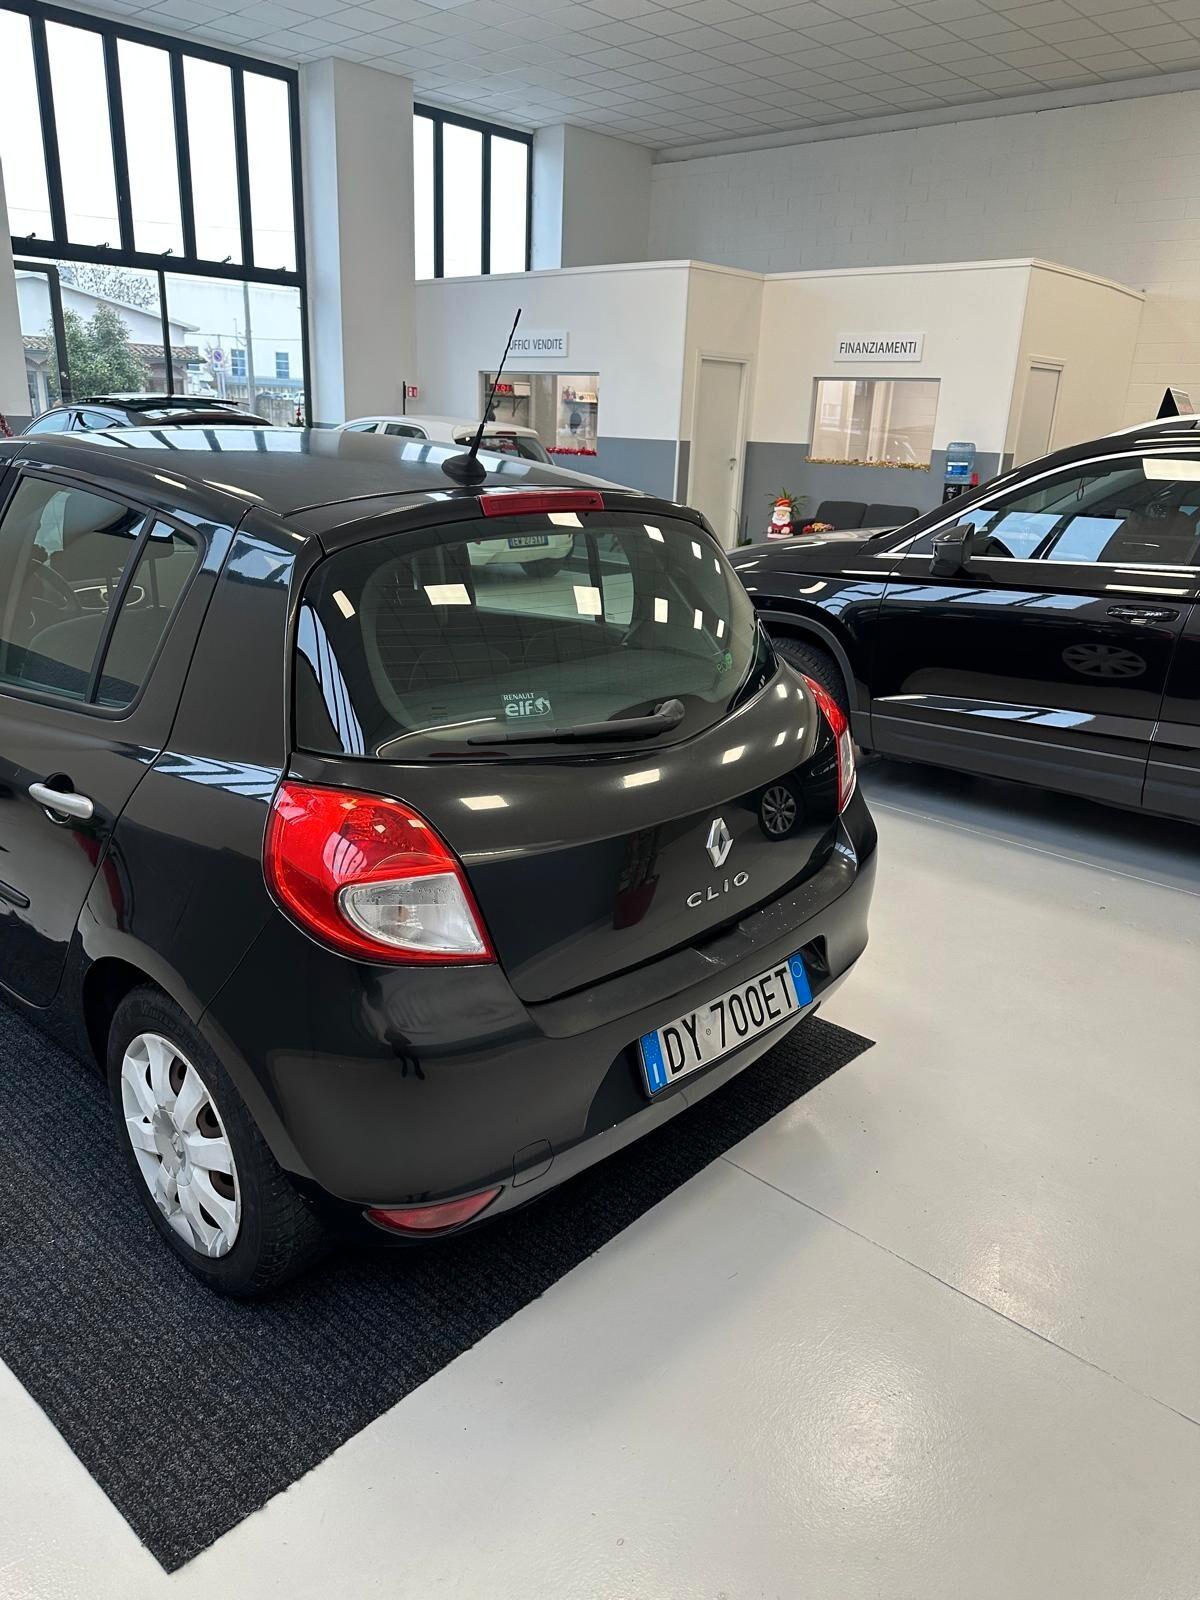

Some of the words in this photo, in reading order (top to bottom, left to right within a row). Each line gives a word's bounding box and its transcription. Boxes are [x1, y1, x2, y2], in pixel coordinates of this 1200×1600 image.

[533, 338, 563, 350] VENDITE
[839, 341, 917, 354] FINANZIAMENTI
[503, 692, 534, 701] RENAULT
[505, 700, 533, 716] elf
[686, 871, 749, 908] CLIO
